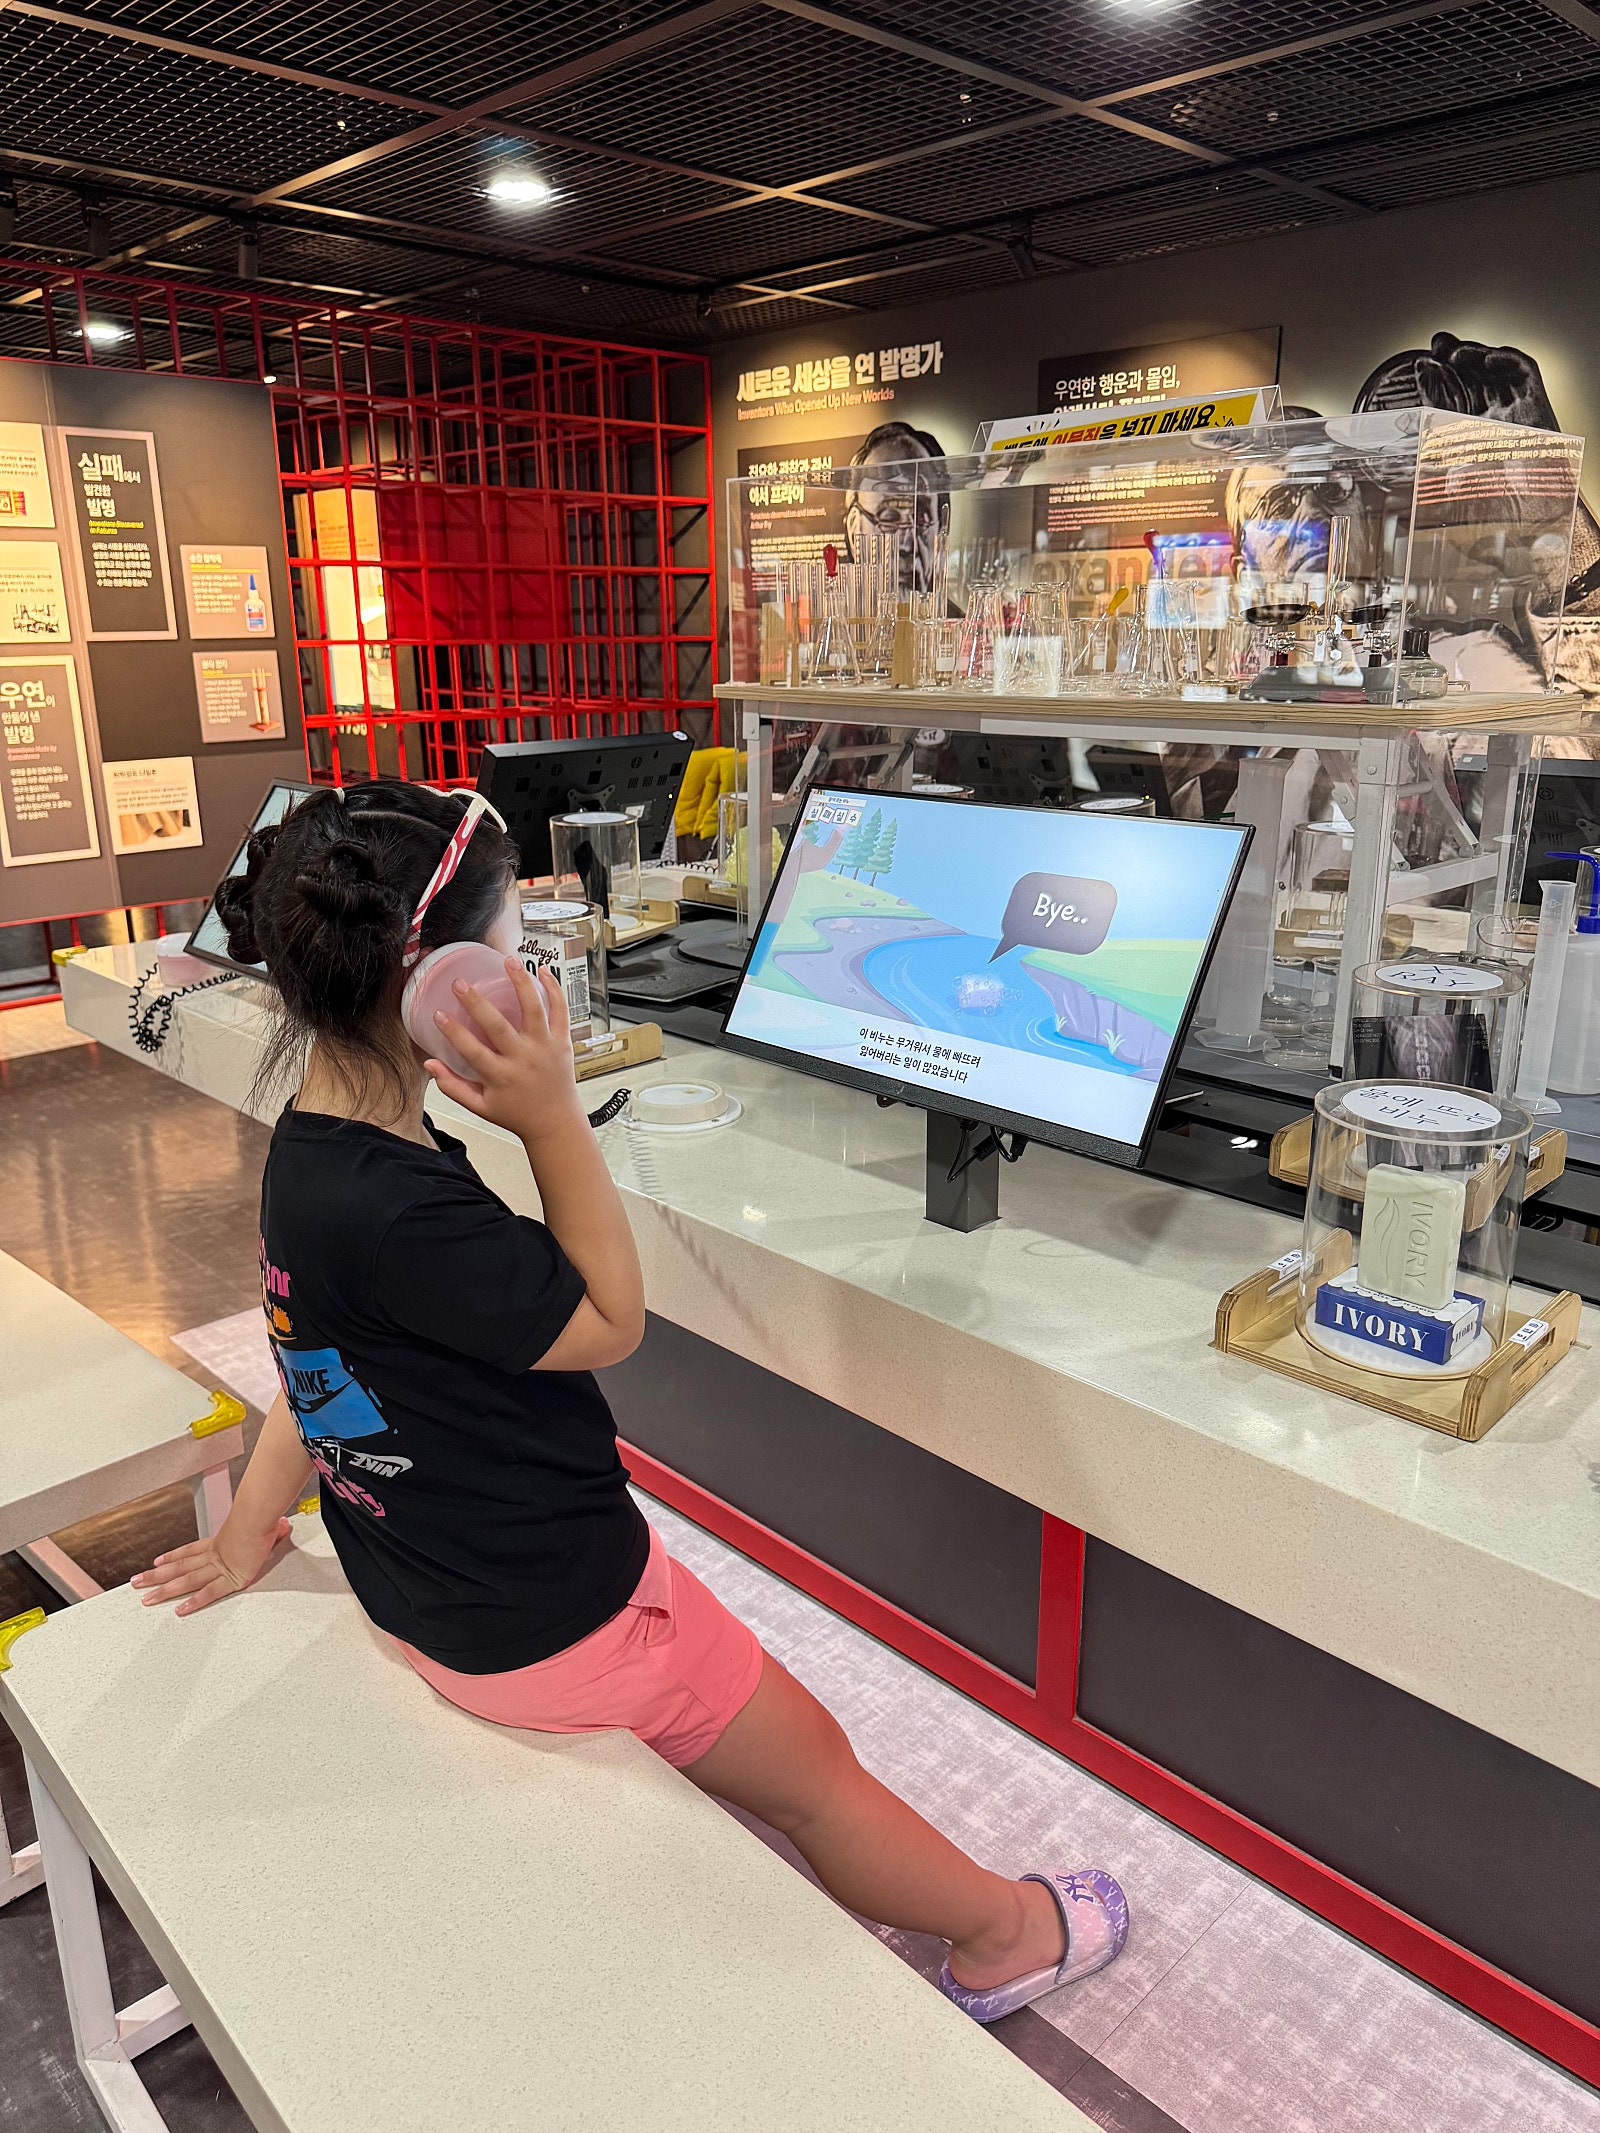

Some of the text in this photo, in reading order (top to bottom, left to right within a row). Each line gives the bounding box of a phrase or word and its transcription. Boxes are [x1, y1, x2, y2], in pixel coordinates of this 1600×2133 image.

[736, 341, 944, 403] 새로운 세상을 연 발명가
[1054, 364, 1181, 401] 우연한 행운과 몰입,
[774, 401, 794, 416] Who
[795, 395, 827, 415] Opened
[828, 395, 841, 411] Up
[841, 392, 863, 407] New
[863, 387, 896, 403] Worlds
[1157, 404, 1216, 434] 마세요
[86, 498, 117, 518] 발명
[749, 484, 805, 507] 아서 프라이
[4, 724, 35, 745] 발명
[1032, 891, 1088, 928] Bye..
[518, 936, 560, 964] ellogg's
[1386, 971, 1475, 987] RAY
[1419, 965, 1467, 975] X-
[859, 1028, 982, 1069] 이 비누는 무거워서 물에 빠뜨려
[859, 1045, 969, 1084] 잃어버리는 일이 많았습니다
[1360, 1088, 1496, 1125] 물에 뜨는
[1378, 1106, 1441, 1125] 비누
[1404, 1201, 1434, 1288] IVORY
[1333, 1302, 1430, 1353] IVORY
[1455, 1321, 1475, 1343] IVORY
[291, 1367, 333, 1396] NIKE
[349, 1455, 401, 1478] NIKE
